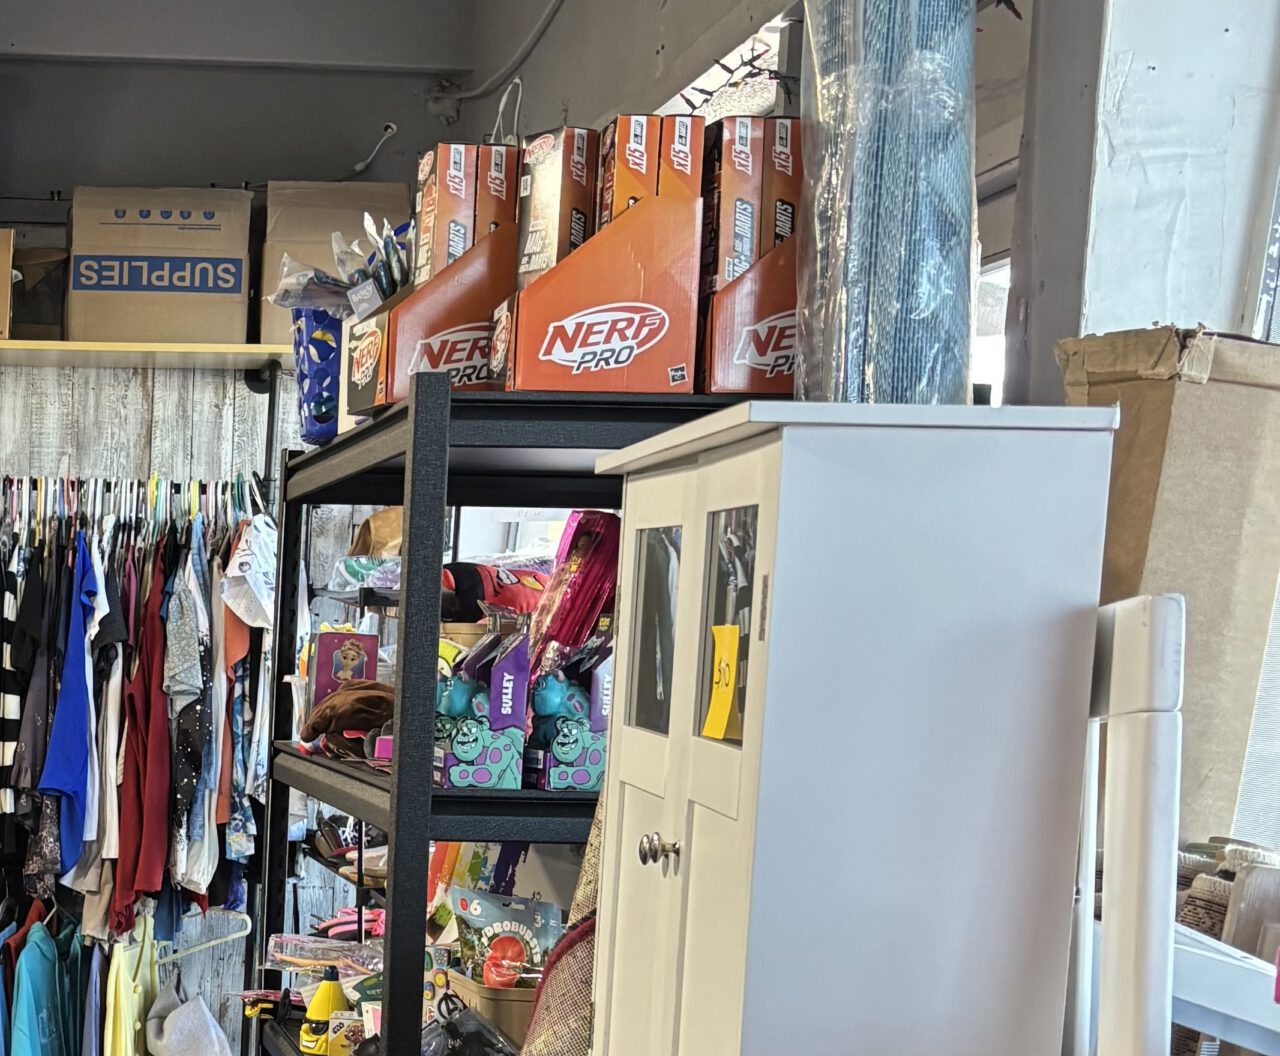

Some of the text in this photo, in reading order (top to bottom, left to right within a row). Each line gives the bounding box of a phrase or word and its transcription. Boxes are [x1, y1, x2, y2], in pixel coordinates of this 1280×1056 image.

[571, 157, 587, 184] x15
[628, 145, 645, 171] x15
[671, 146, 689, 173] x15
[733, 149, 750, 172] x15
[772, 149, 791, 173] x15
[448, 172, 465, 198] x15
[488, 174, 505, 198] x15
[571, 209, 586, 246] DARTS
[736, 199, 753, 236] DARTS
[775, 199, 793, 237] DARTS
[449, 221, 466, 257] DARTS
[79, 260, 236, 289] SUPPLIES
[542, 313, 666, 358] NERF
[734, 325, 796, 361] NE
[352, 333, 381, 381] NERF
[418, 336, 491, 370] NER
[575, 345, 634, 371] PRO
[501, 672, 514, 715] SULLEY
